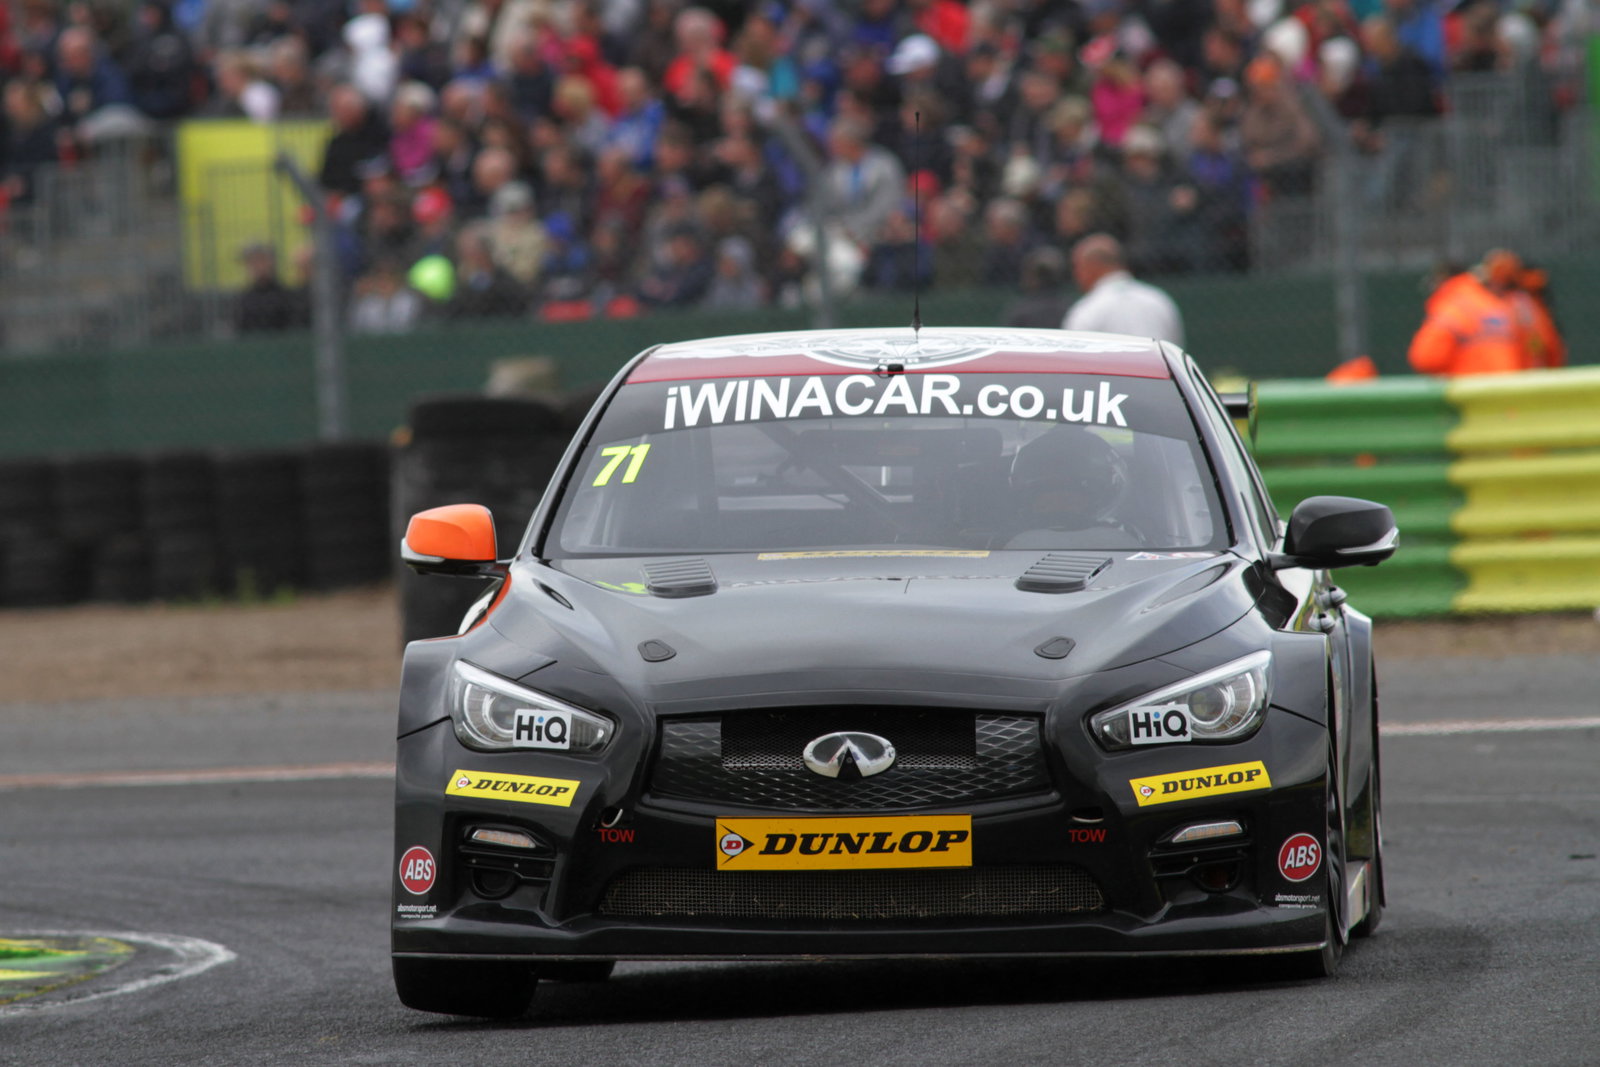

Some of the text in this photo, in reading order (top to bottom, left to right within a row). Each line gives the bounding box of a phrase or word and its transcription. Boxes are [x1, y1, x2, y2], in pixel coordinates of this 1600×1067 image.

[664, 374, 1129, 430] iWINACAR.co.uk
[592, 443, 651, 487] 71
[516, 714, 567, 745] HiQ
[1132, 709, 1188, 738] HiQ
[473, 779, 570, 797] DUNLOP
[1161, 768, 1262, 795] DUNLOP
[598, 828, 636, 843] TOW
[758, 830, 969, 856] DUNLOP
[1068, 829, 1107, 843] TOW
[404, 858, 433, 881] ABS
[1284, 843, 1318, 870] ABS
